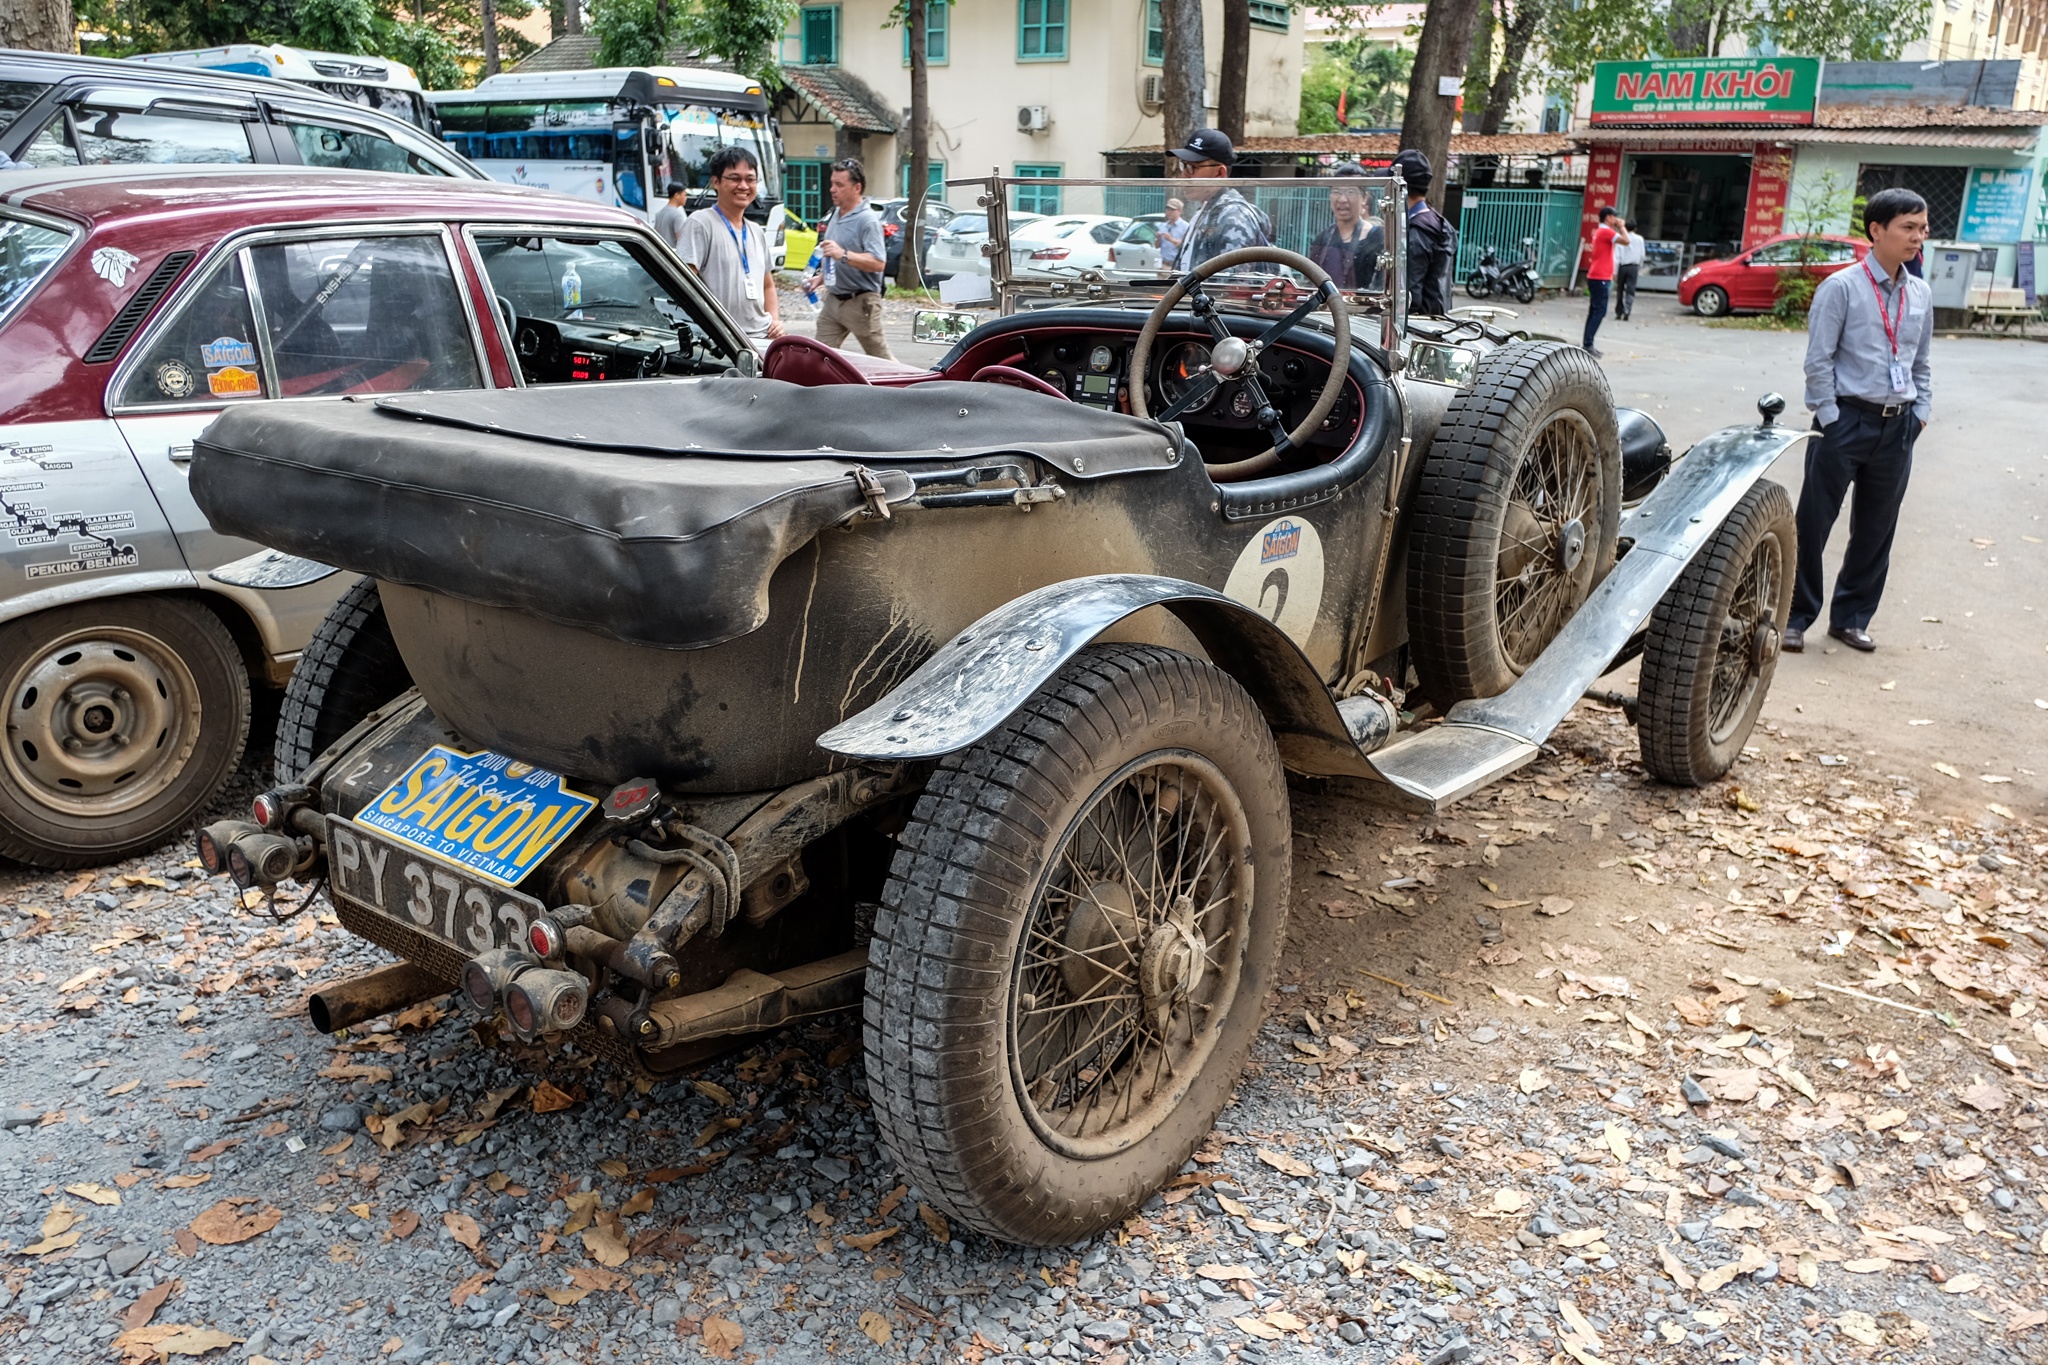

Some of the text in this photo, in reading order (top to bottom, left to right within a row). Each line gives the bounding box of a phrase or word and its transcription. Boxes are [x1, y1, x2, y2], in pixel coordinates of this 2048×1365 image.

[1614, 63, 1794, 100] NAM KHÔI
[1632, 102, 1655, 113] CHỤP
[1715, 101, 1732, 110] SAU
[1741, 99, 1766, 109] PHÚT
[204, 346, 253, 362] SAIGON
[32, 445, 53, 453] NHON
[44, 462, 72, 470] SAIGON
[13, 503, 30, 511] AYA
[24, 509, 46, 517] ALTAI
[53, 513, 81, 522] MURUN
[85, 513, 133, 525] ULAAN BAATAR
[10, 527, 35, 535] OLGIY
[19, 536, 55, 546] ULIASTAI
[73, 542, 108, 552] ERENHOT
[1262, 528, 1300, 559] SAIGON
[82, 550, 112, 559] DATONG
[29, 554, 137, 577] PEKING/BEIJING
[344, 761, 373, 786] 2
[477, 753, 511, 772] 2018
[523, 769, 557, 789] 2018
[456, 764, 537, 810] The Road to
[379, 757, 584, 868] SAIGON
[363, 810, 518, 880] SINGAPORE TO VIETNAM
[334, 828, 530, 953] PY 3733
